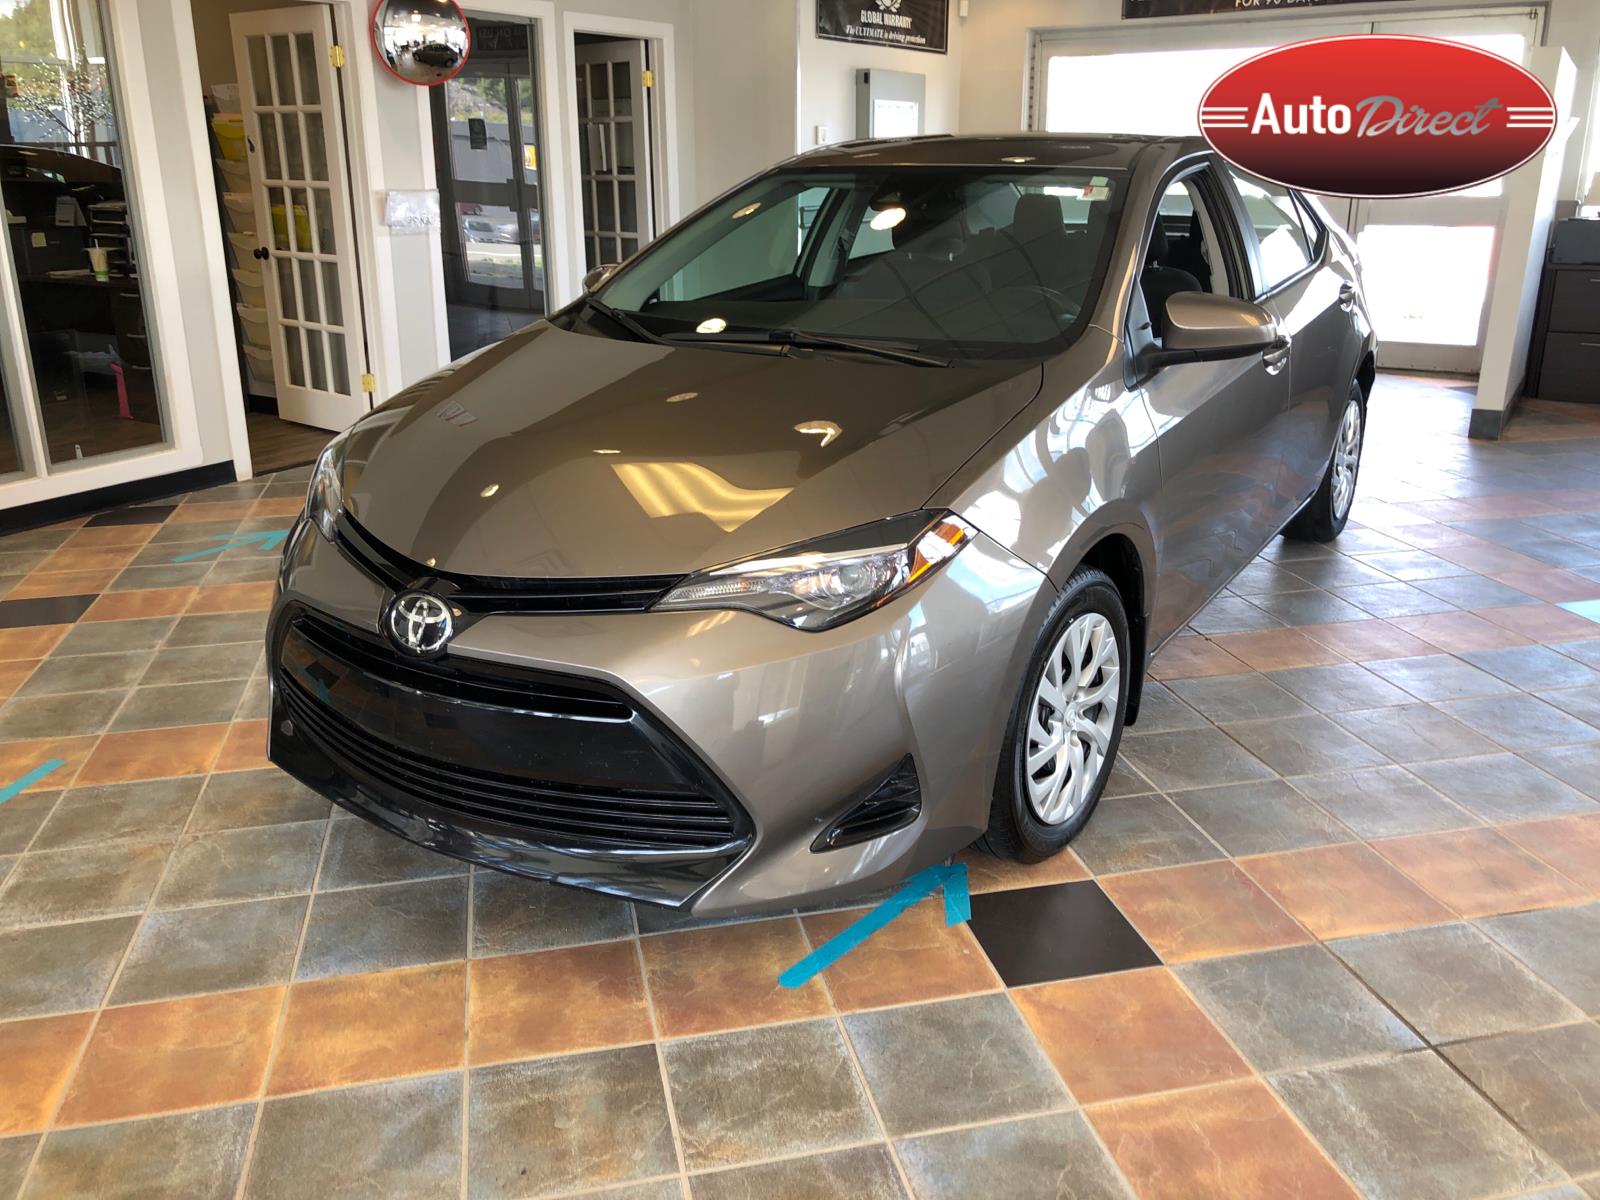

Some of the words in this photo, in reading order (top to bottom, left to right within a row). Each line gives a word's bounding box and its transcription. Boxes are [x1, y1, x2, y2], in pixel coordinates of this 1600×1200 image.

[860, 9, 883, 24] GLOBAL
[883, 13, 912, 29] WARRANTY
[855, 26, 883, 38] ULTIMATE
